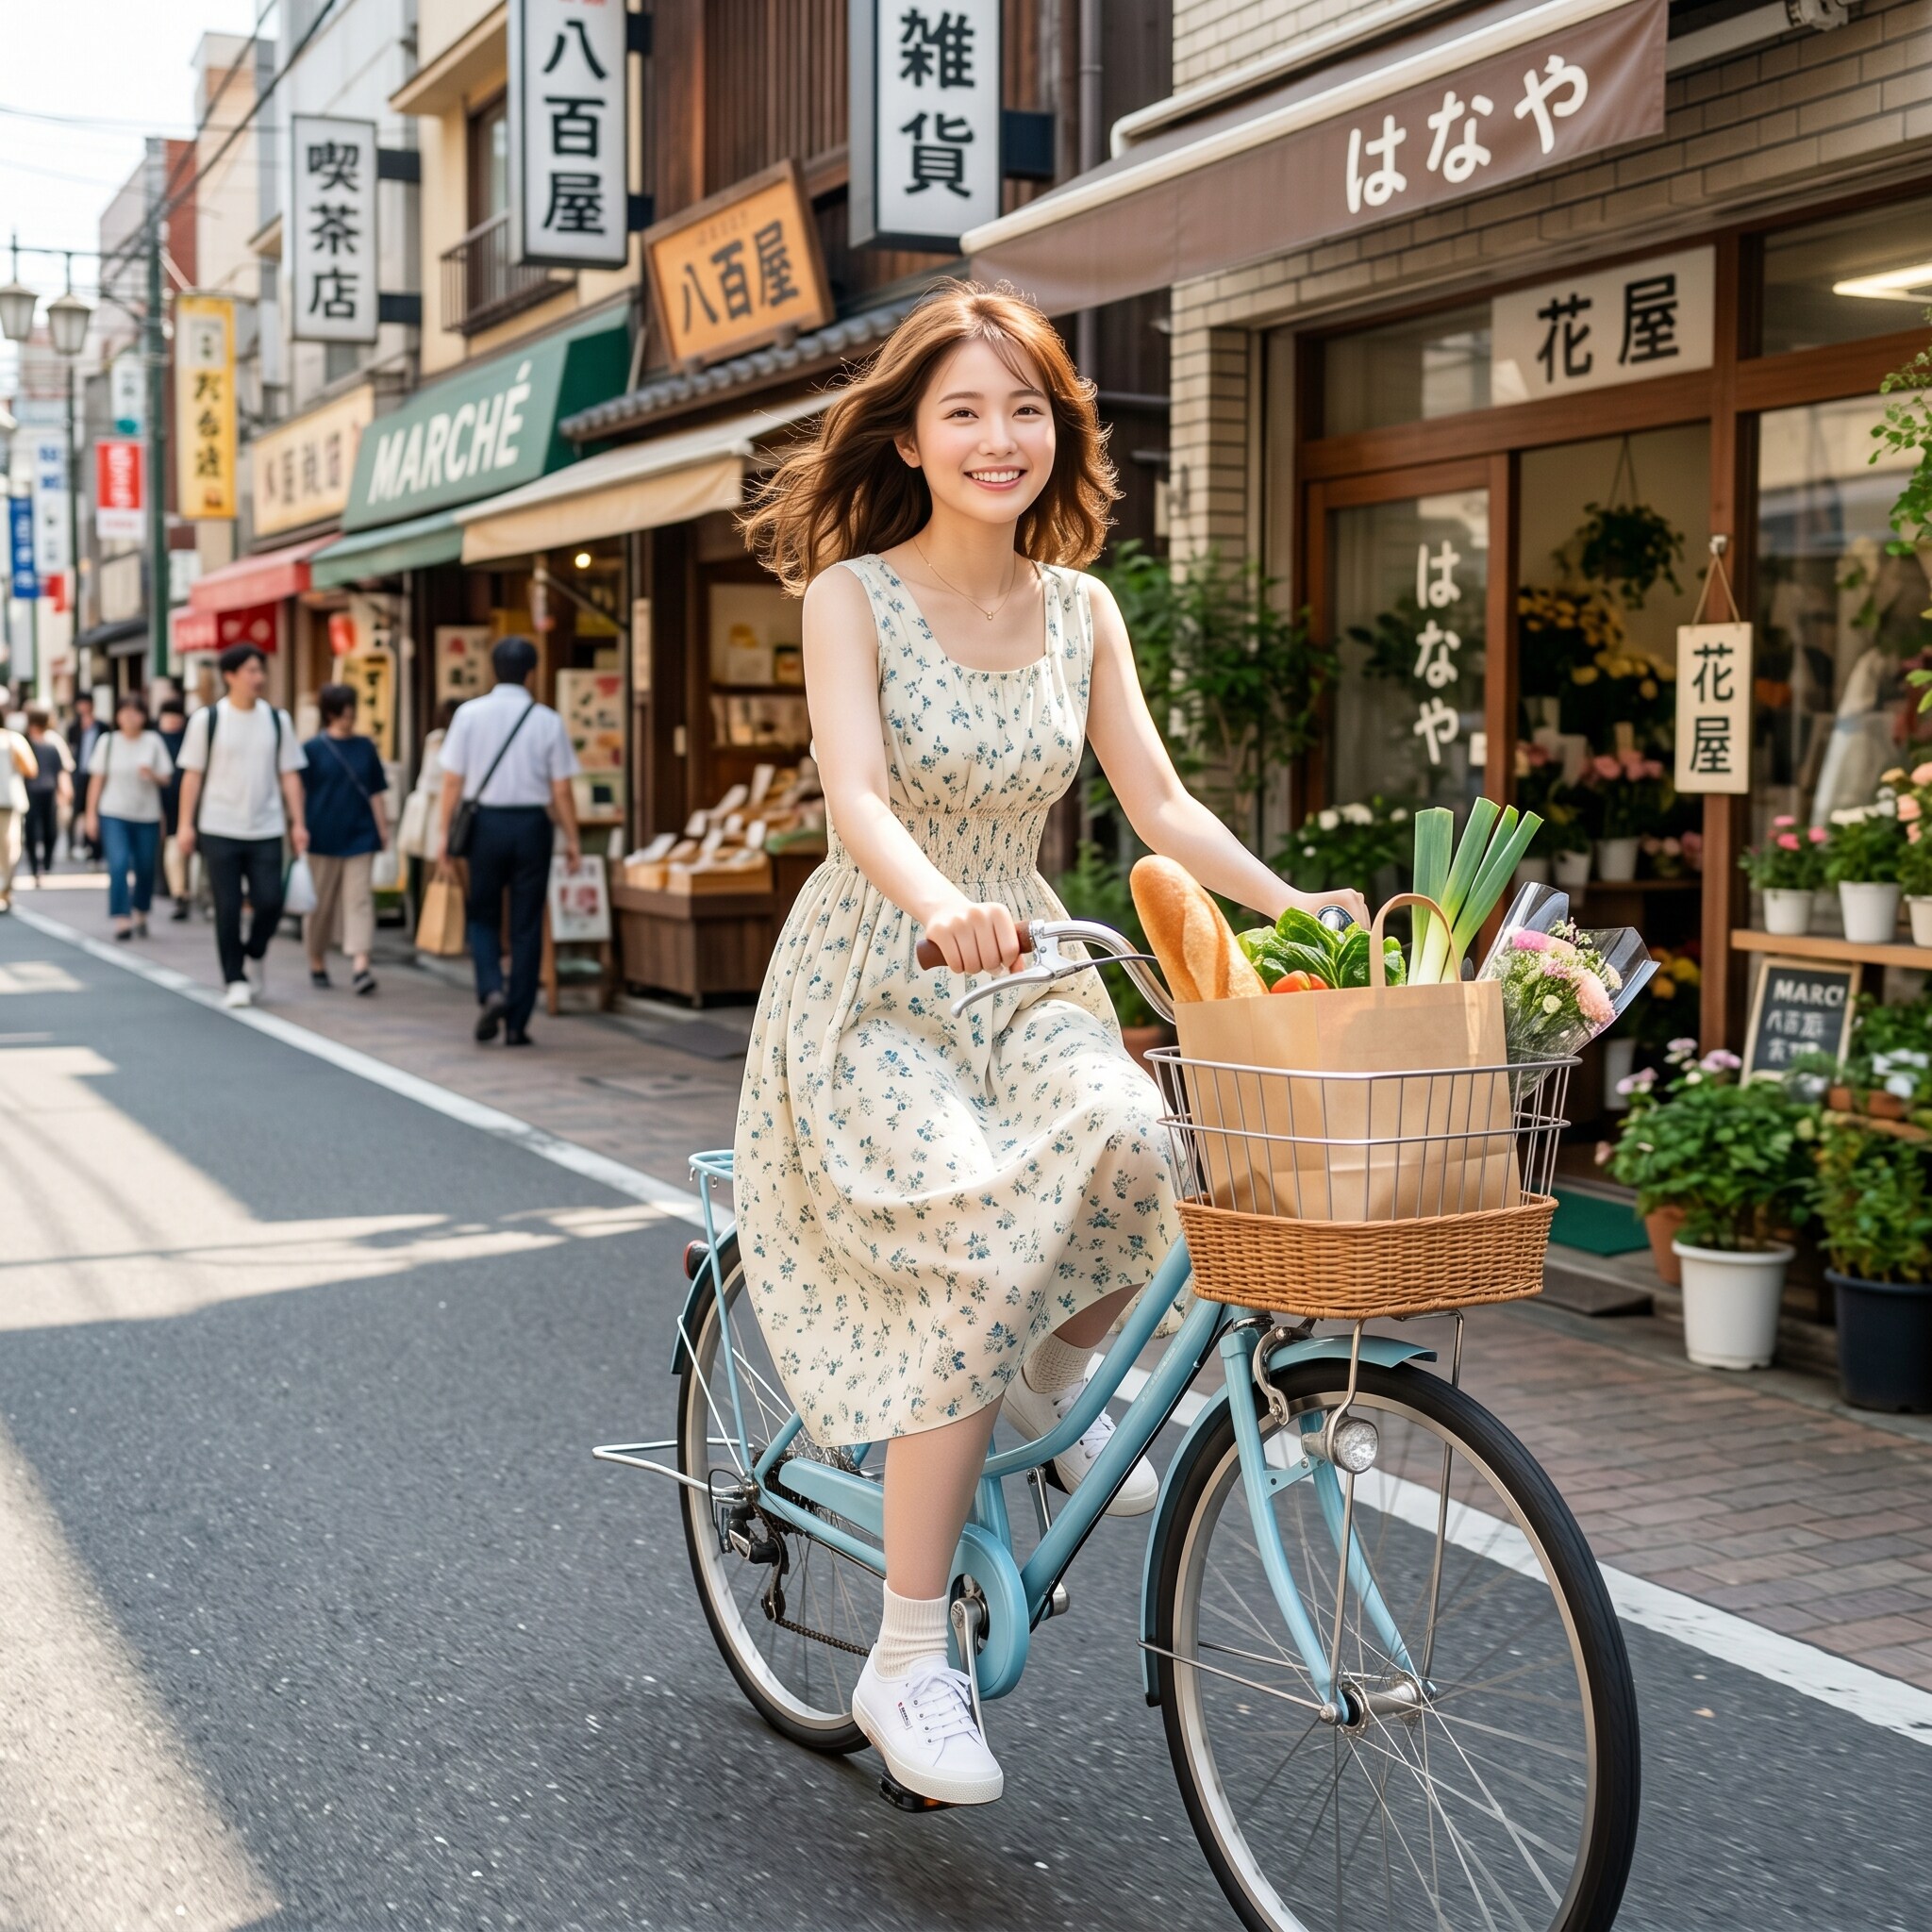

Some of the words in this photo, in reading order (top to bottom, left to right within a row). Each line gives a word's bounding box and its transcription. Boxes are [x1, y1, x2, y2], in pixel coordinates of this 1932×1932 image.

[541, 20, 608, 237] 八百屋
[900, 8, 976, 199] 雑貨
[1345, 54, 1590, 214] はなや
[307, 141, 360, 322] 喫茶店
[680, 219, 799, 336] 八百屋
[1537, 273, 1681, 384] 花屋
[367, 359, 532, 506] MARCHÉ
[1414, 540, 1461, 765] はなや
[1690, 642, 1735, 774] 花屋
